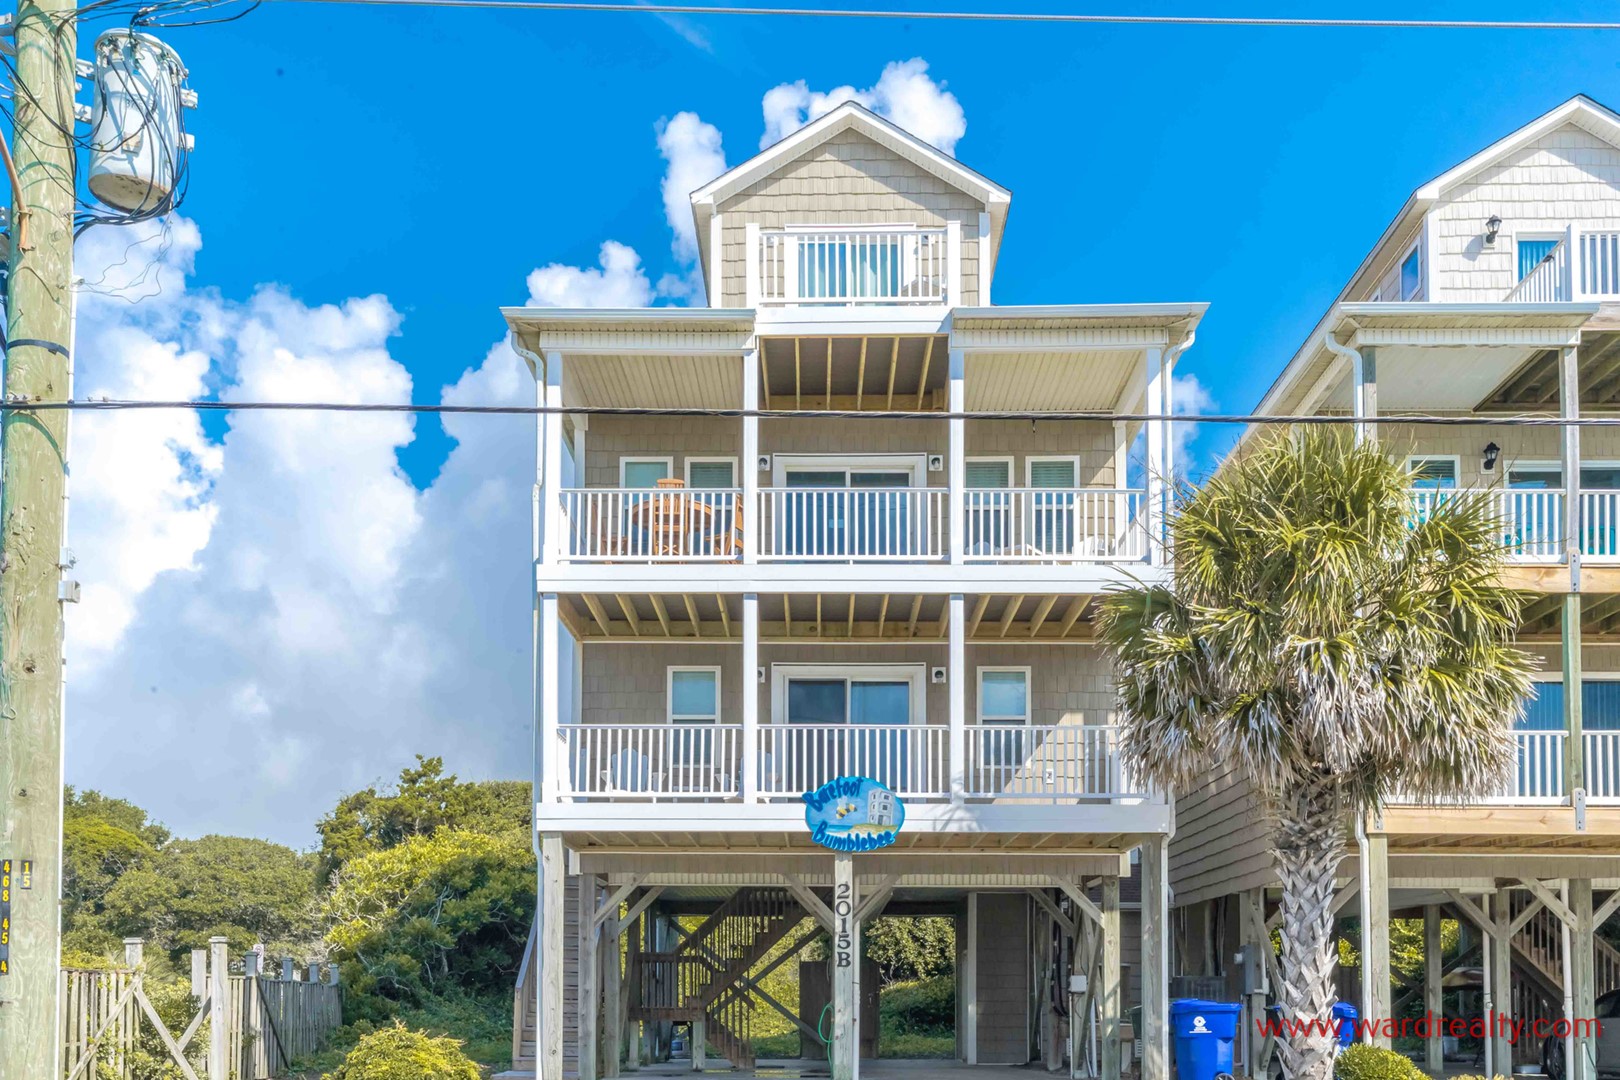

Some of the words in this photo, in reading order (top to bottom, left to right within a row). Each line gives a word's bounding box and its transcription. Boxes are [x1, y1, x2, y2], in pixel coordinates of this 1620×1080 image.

[802, 777, 864, 812] Barefoot
[812, 820, 895, 851] Bumblebee
[835, 883, 851, 968] 2015B
